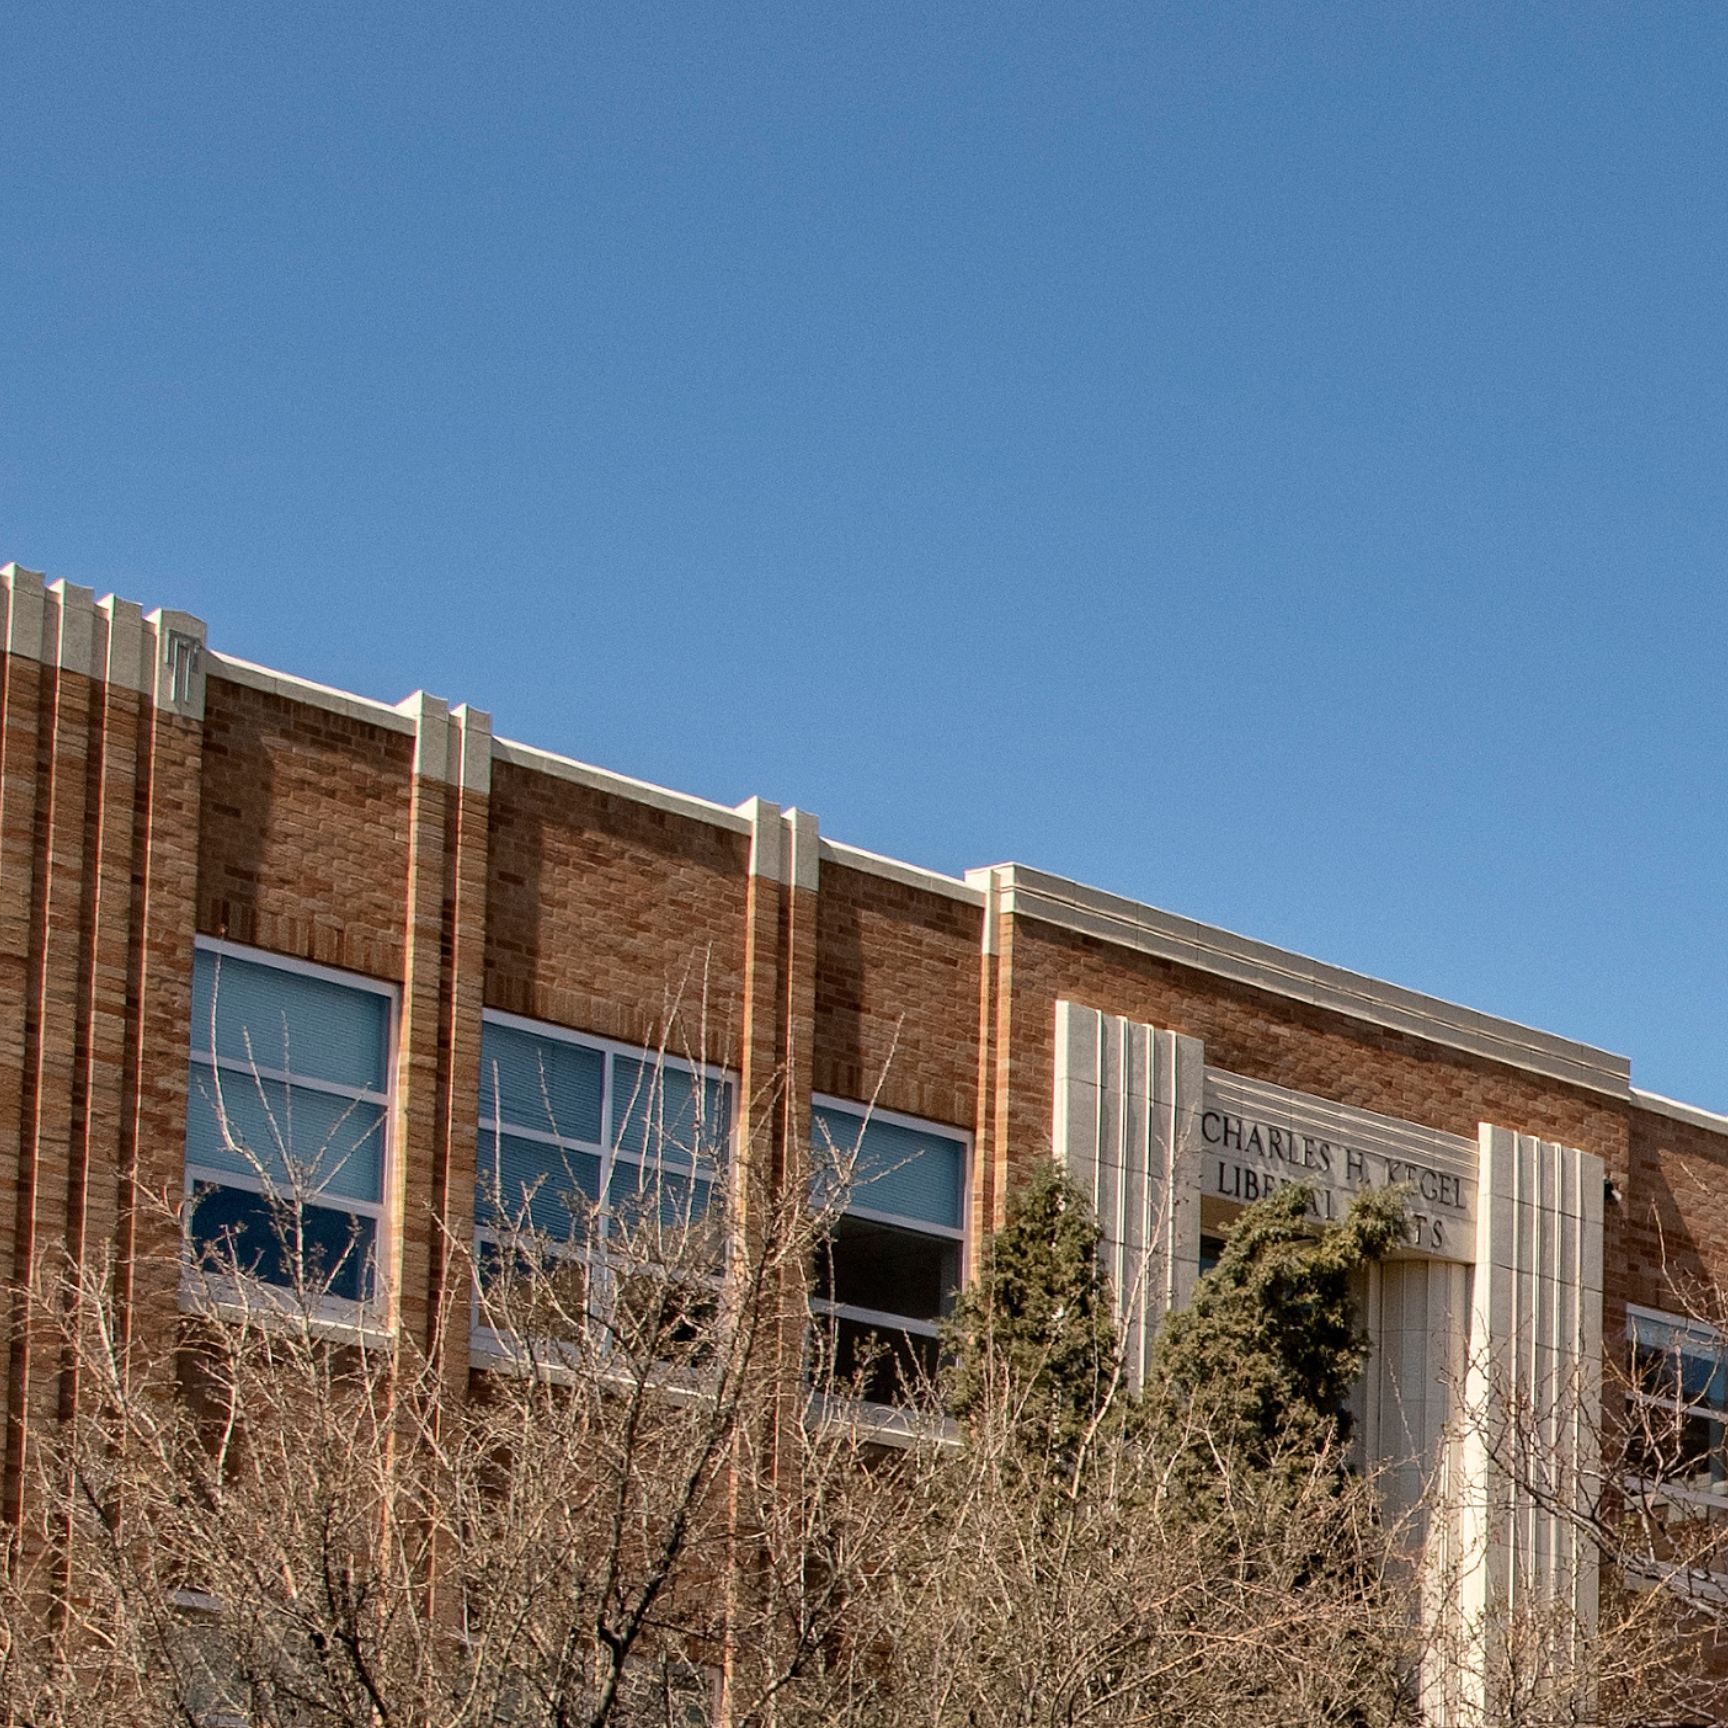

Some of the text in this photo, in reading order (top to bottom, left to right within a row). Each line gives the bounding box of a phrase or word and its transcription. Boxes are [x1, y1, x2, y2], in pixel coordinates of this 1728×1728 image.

[1201, 1110, 1331, 1173] CHARLES
[1381, 1157, 1467, 1211] KEGEL
[1217, 1160, 1334, 1220] LIBEAL
